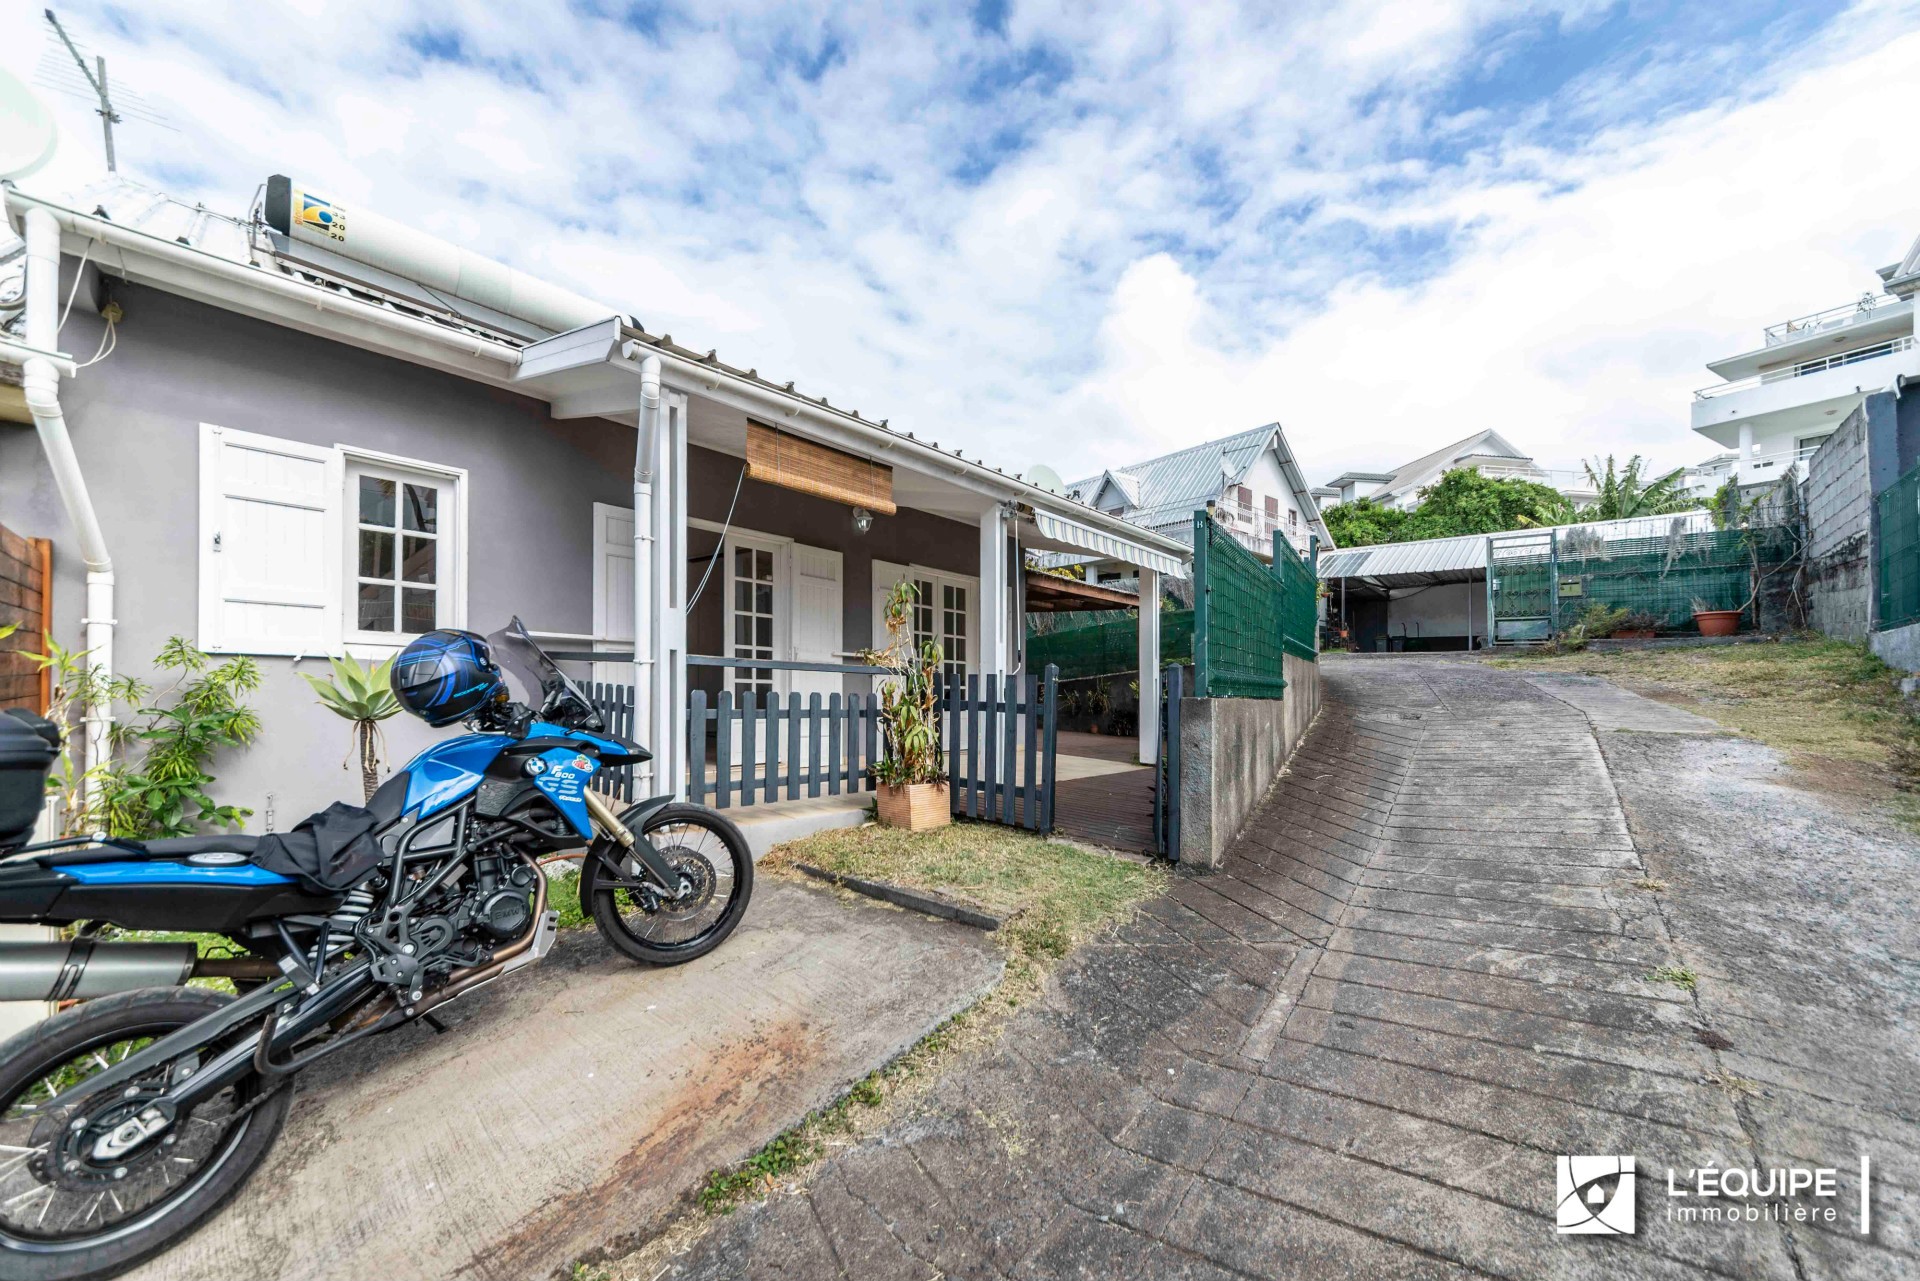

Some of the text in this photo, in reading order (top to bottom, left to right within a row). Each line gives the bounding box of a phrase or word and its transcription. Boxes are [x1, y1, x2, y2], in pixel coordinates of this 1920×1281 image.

[332, 222, 345, 230] 20
[331, 233, 344, 241] 20
[550, 765, 564, 775] F
[537, 777, 579, 794] GS
